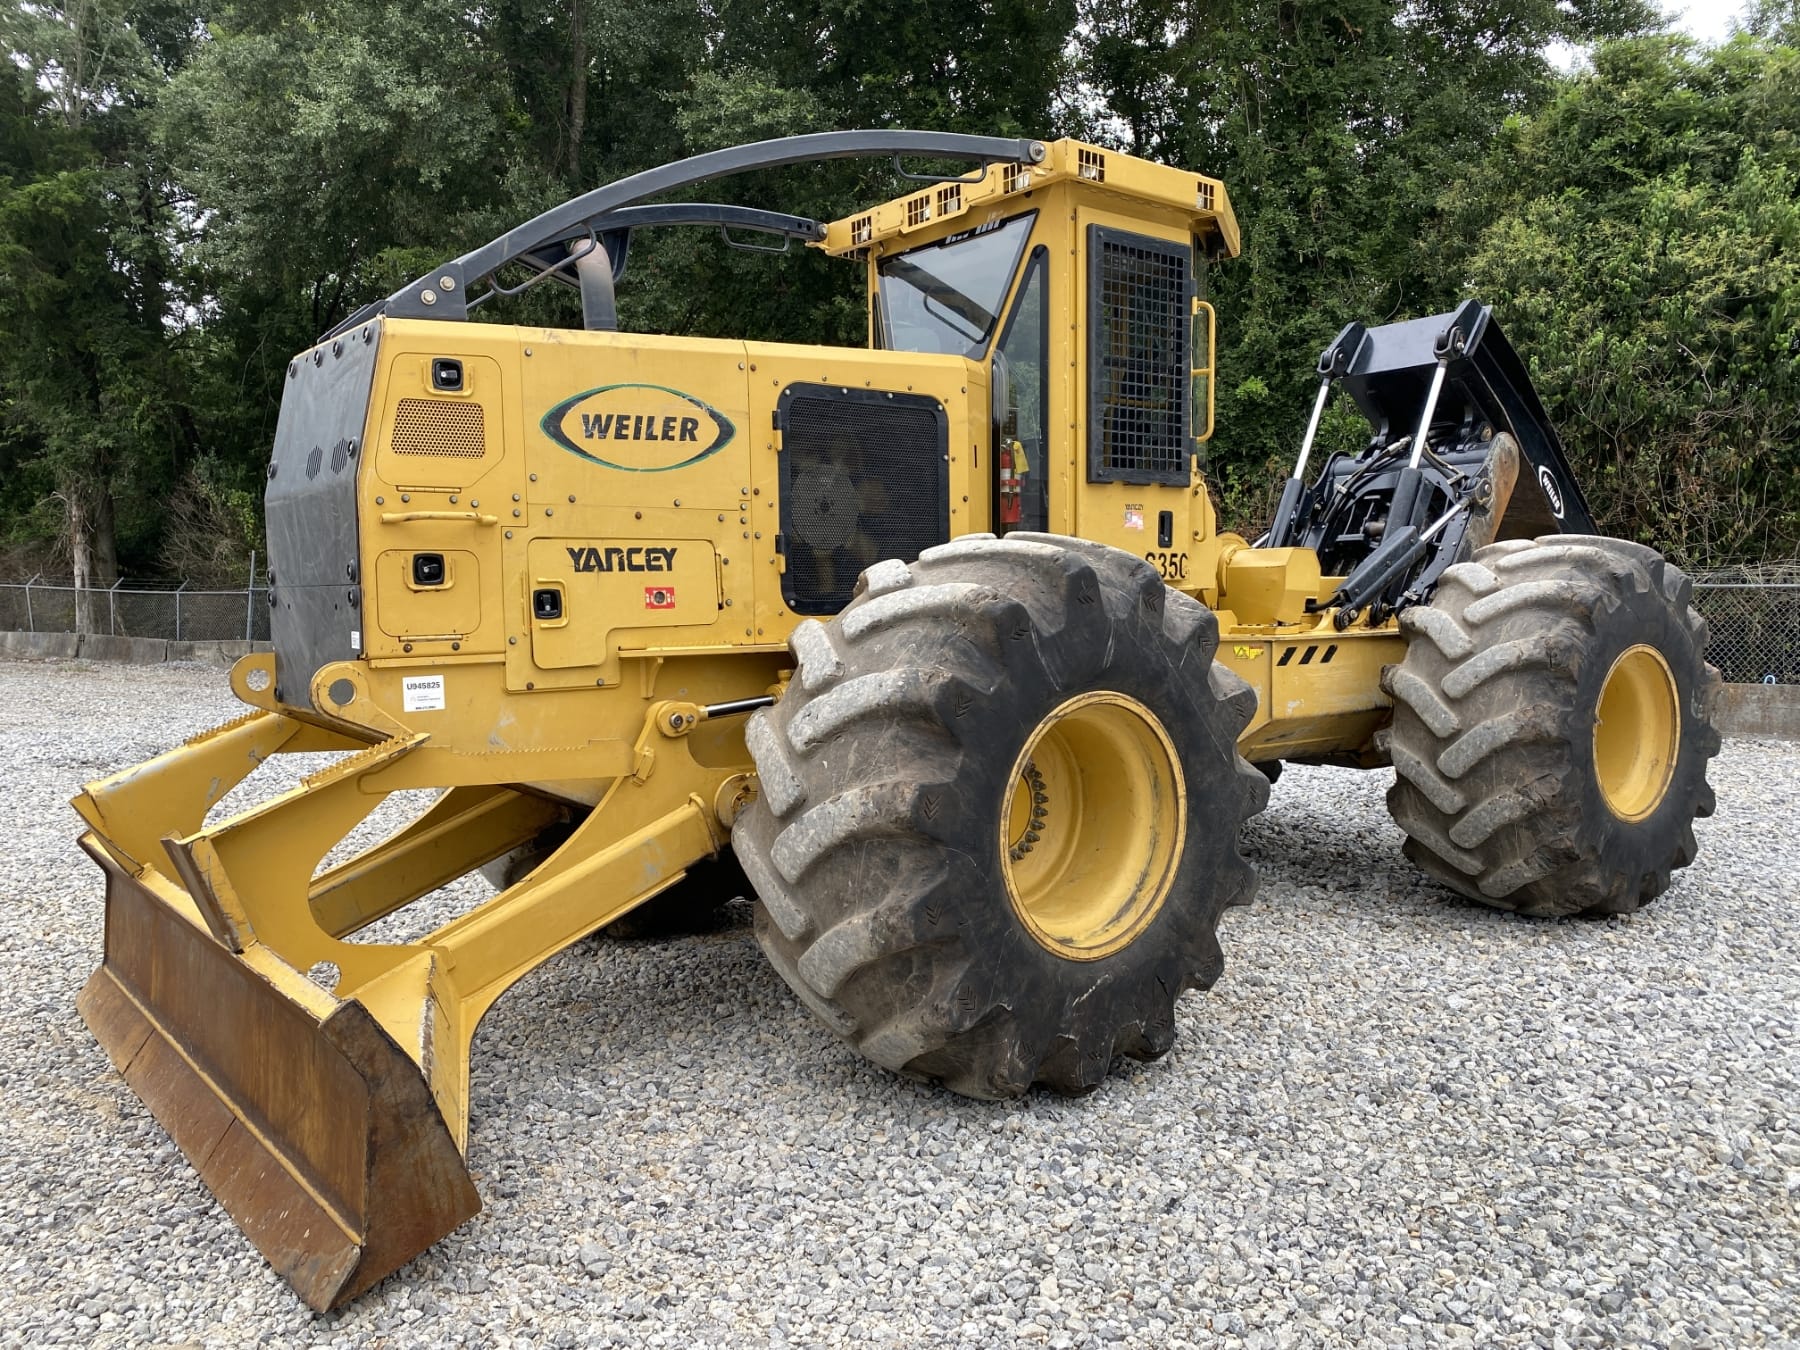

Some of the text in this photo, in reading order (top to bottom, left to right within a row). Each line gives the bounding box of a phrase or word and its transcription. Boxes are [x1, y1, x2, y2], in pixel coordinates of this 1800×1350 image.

[581, 413, 700, 442] WEILER
[1542, 473, 1561, 511] WEILER
[566, 547, 678, 573] YANCEY
[406, 681, 441, 690] U945825
